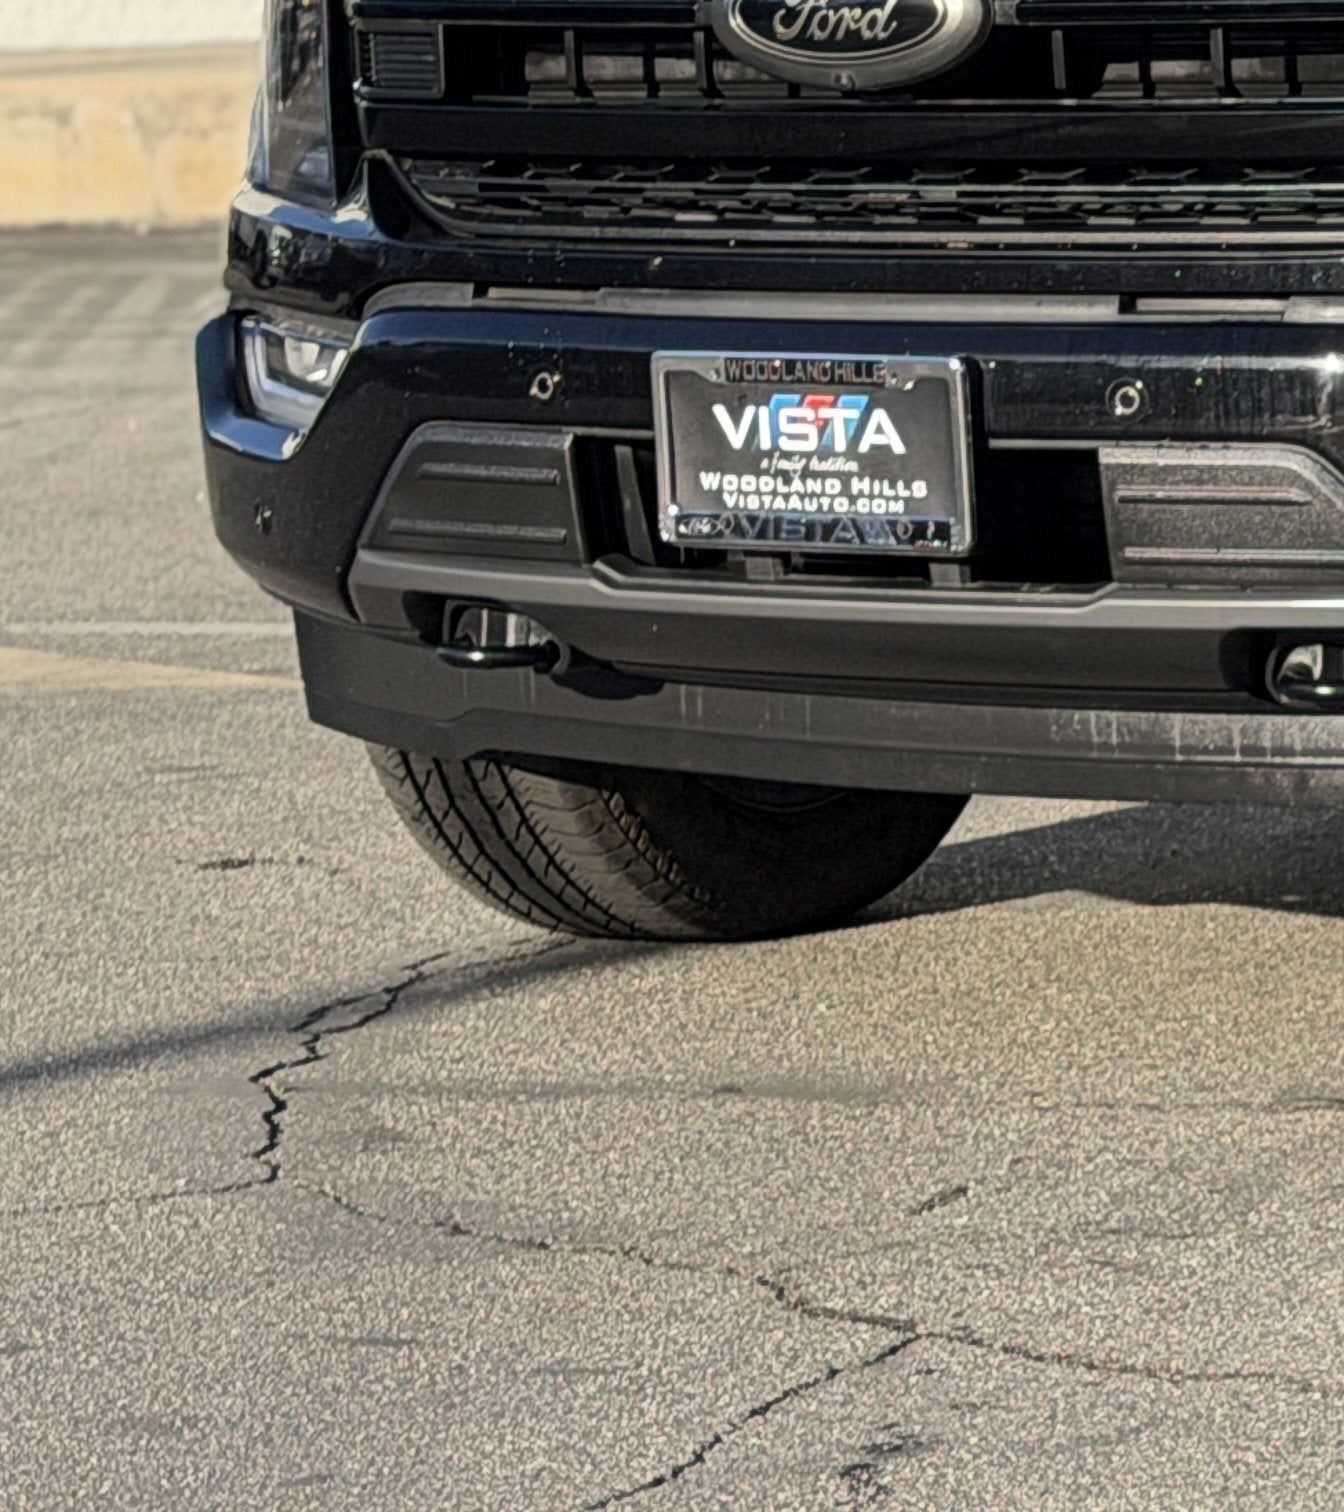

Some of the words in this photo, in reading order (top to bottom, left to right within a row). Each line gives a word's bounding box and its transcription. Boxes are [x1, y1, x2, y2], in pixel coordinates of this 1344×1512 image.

[726, 360, 831, 383] WOODLAND
[712, 403, 906, 455] VISTA
[699, 472, 842, 495] WOODLAND
[851, 476, 928, 499] HILLS
